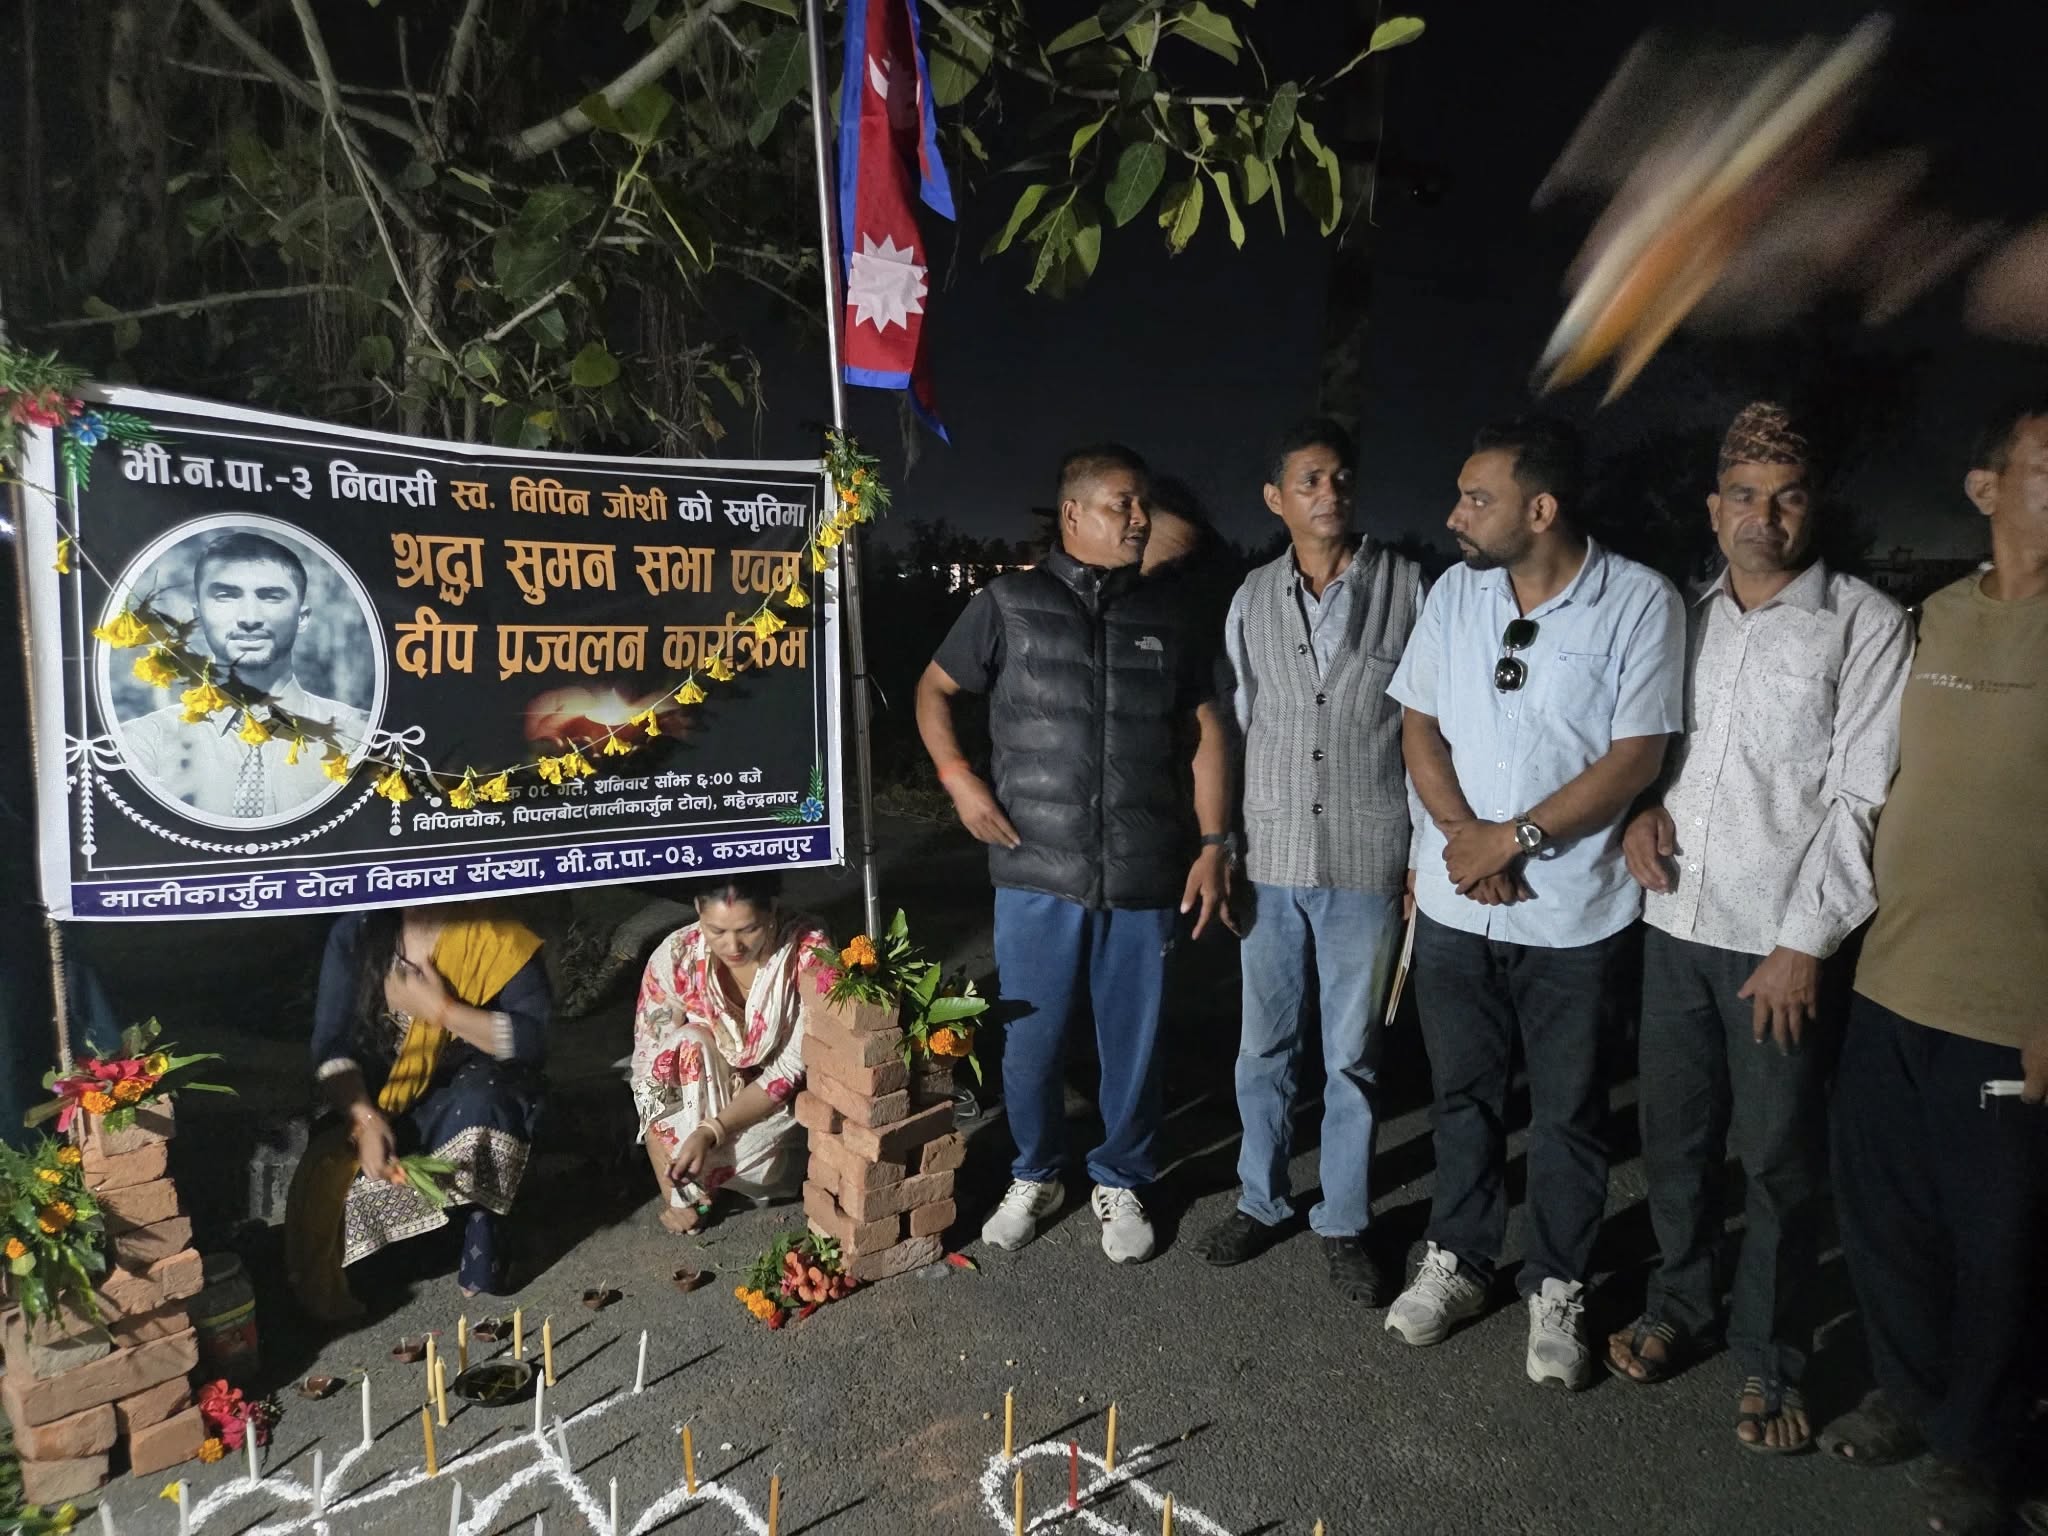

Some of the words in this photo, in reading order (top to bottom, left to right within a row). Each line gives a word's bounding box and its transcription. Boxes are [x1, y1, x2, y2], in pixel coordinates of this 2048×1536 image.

[121, 444, 312, 499] भी.न.पा.-३
[329, 460, 437, 507] निवासी
[450, 481, 495, 511] स्व.
[510, 476, 591, 516] विपिन
[602, 484, 667, 522] जोशी
[678, 490, 712, 523] को
[723, 494, 806, 533] स्मृतिमा
[391, 533, 485, 606] श्रद्धा
[504, 540, 617, 606] सुमन
[634, 546, 715, 596] सभा
[395, 606, 479, 679] दीप
[497, 625, 648, 681] प्रज्वलन
[662, 612, 808, 671] कार्यक्रम
[413, 810, 506, 832] विपिनचोक,
[678, 793, 717, 811] टोल),
[723, 790, 798, 809] महेन्द्रनगर
[595, 775, 649, 795] शनिवार
[654, 770, 692, 789] साँझ
[739, 767, 762, 784] बजे
[100, 875, 286, 910] मालीकार्जुन
[297, 872, 356, 898] टोल
[366, 866, 458, 893] विकास
[467, 857, 545, 883] संस्था,
[712, 834, 814, 861] कञ्चनपुर
